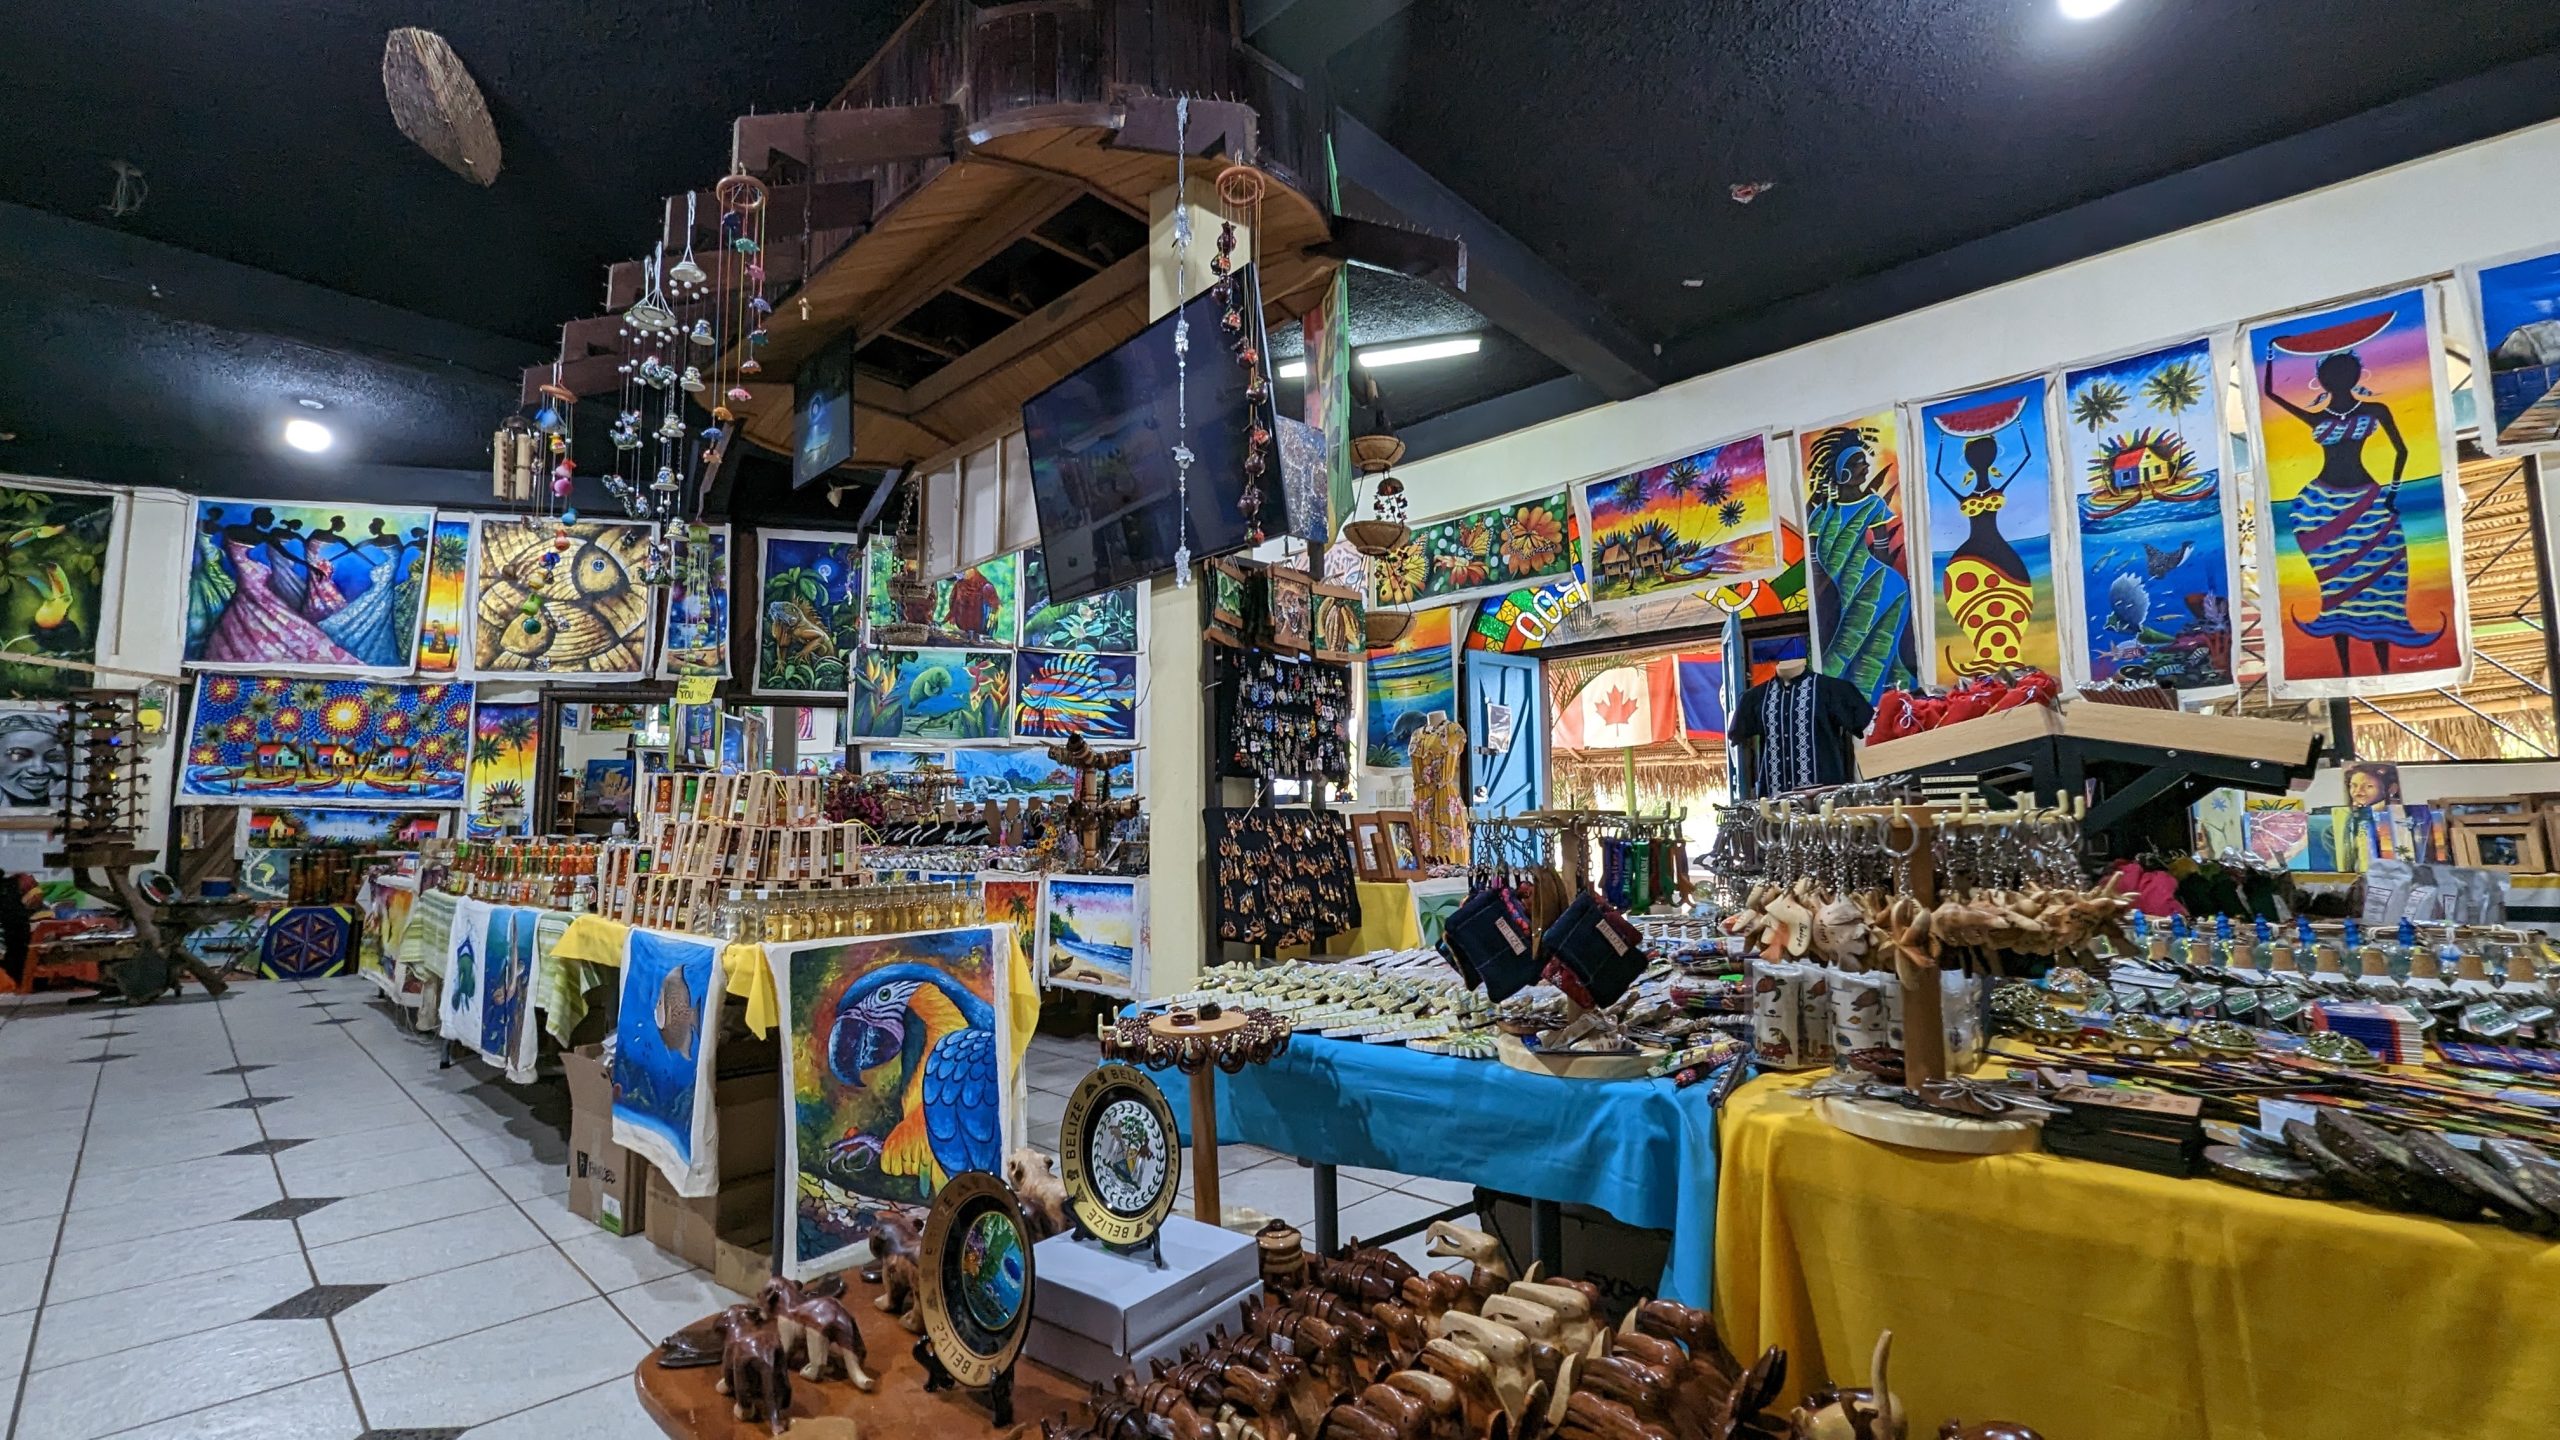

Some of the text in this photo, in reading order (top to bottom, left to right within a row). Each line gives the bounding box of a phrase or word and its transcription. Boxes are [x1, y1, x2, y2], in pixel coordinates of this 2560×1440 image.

[679, 688, 695, 700] YOU
[1498, 919, 1524, 952] BELIZE
[1599, 921, 1626, 953] BELIZE
[1111, 1068, 1146, 1088] BELIZ
[1065, 1103, 1085, 1160] BELIZE
[1162, 1144, 1177, 1206] BELIZE
[1086, 1207, 1130, 1239] BELIZE
[931, 1320, 972, 1376] BELIZE
